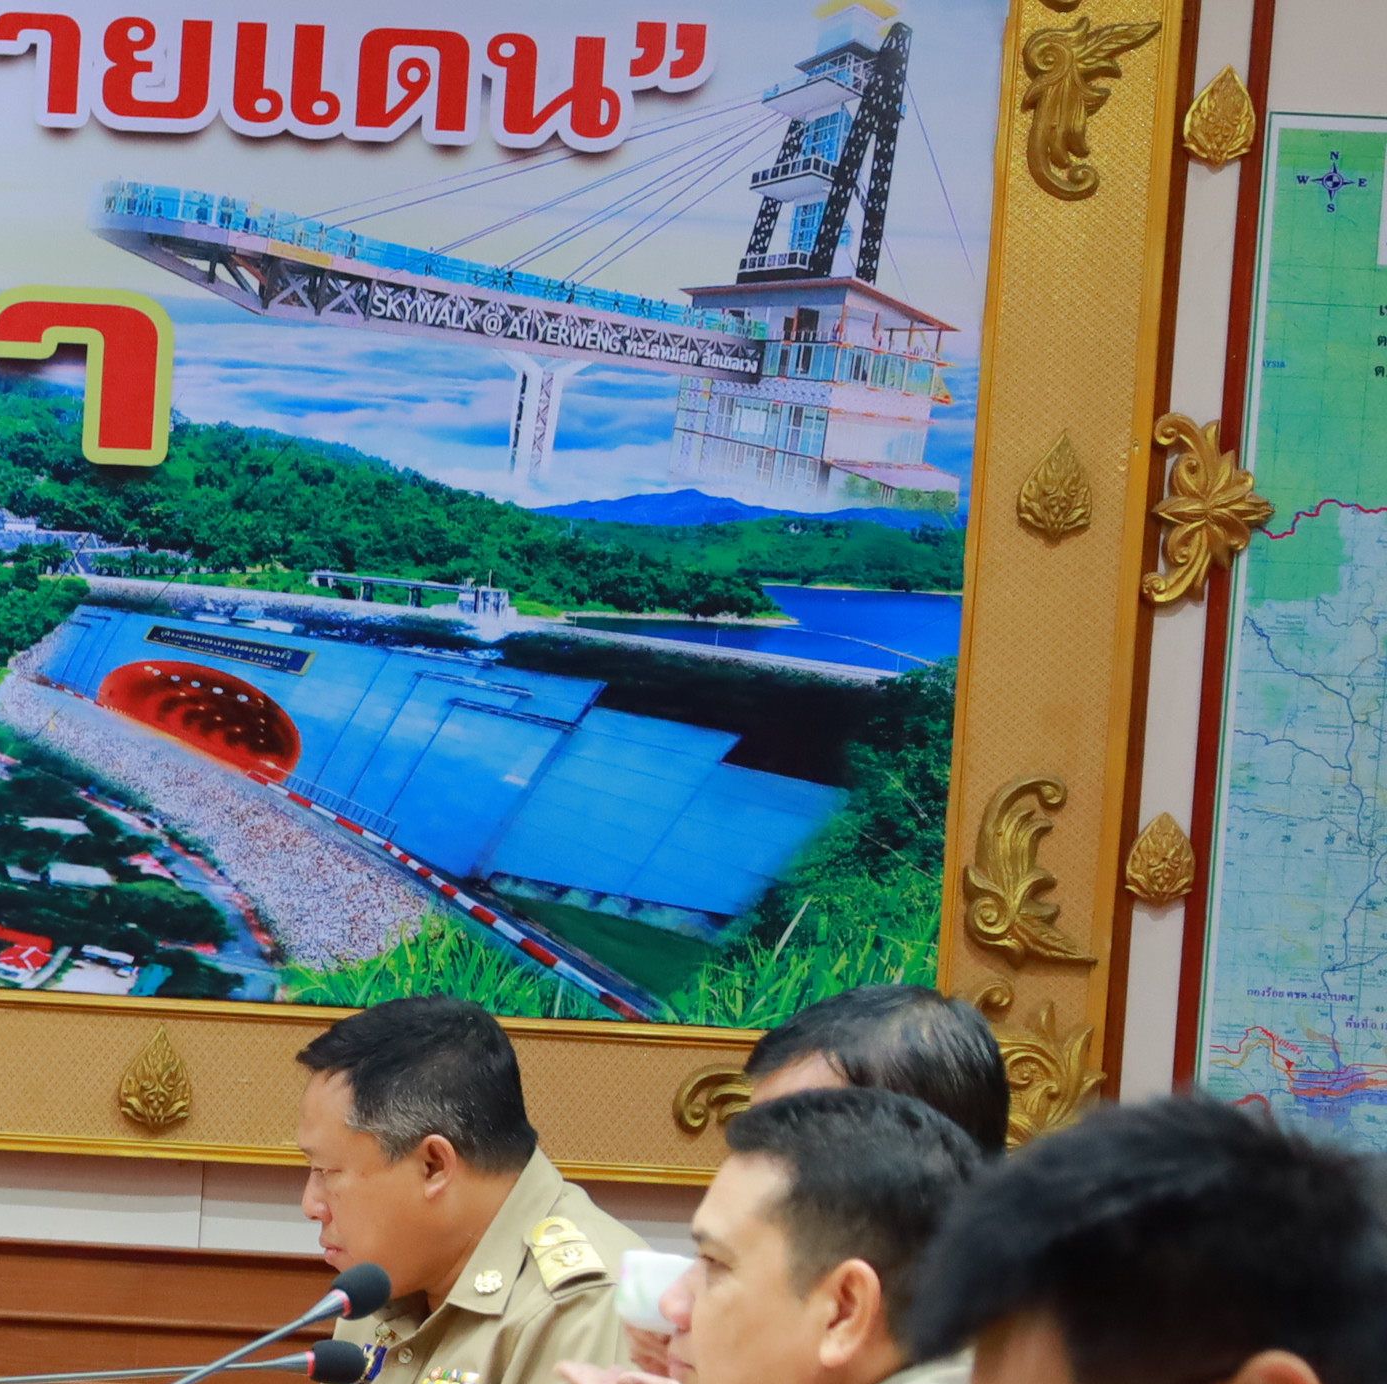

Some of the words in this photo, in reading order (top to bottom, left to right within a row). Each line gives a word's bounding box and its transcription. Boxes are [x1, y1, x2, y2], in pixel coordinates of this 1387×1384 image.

[1330, 151, 1339, 160] N
[1296, 175, 1310, 184] W
[1358, 178, 1367, 188] E
[1327, 204, 1336, 213] S
[370, 293, 477, 332] SKYWALK
[482, 311, 503, 337] @
[535, 320, 622, 353] YERWENG
